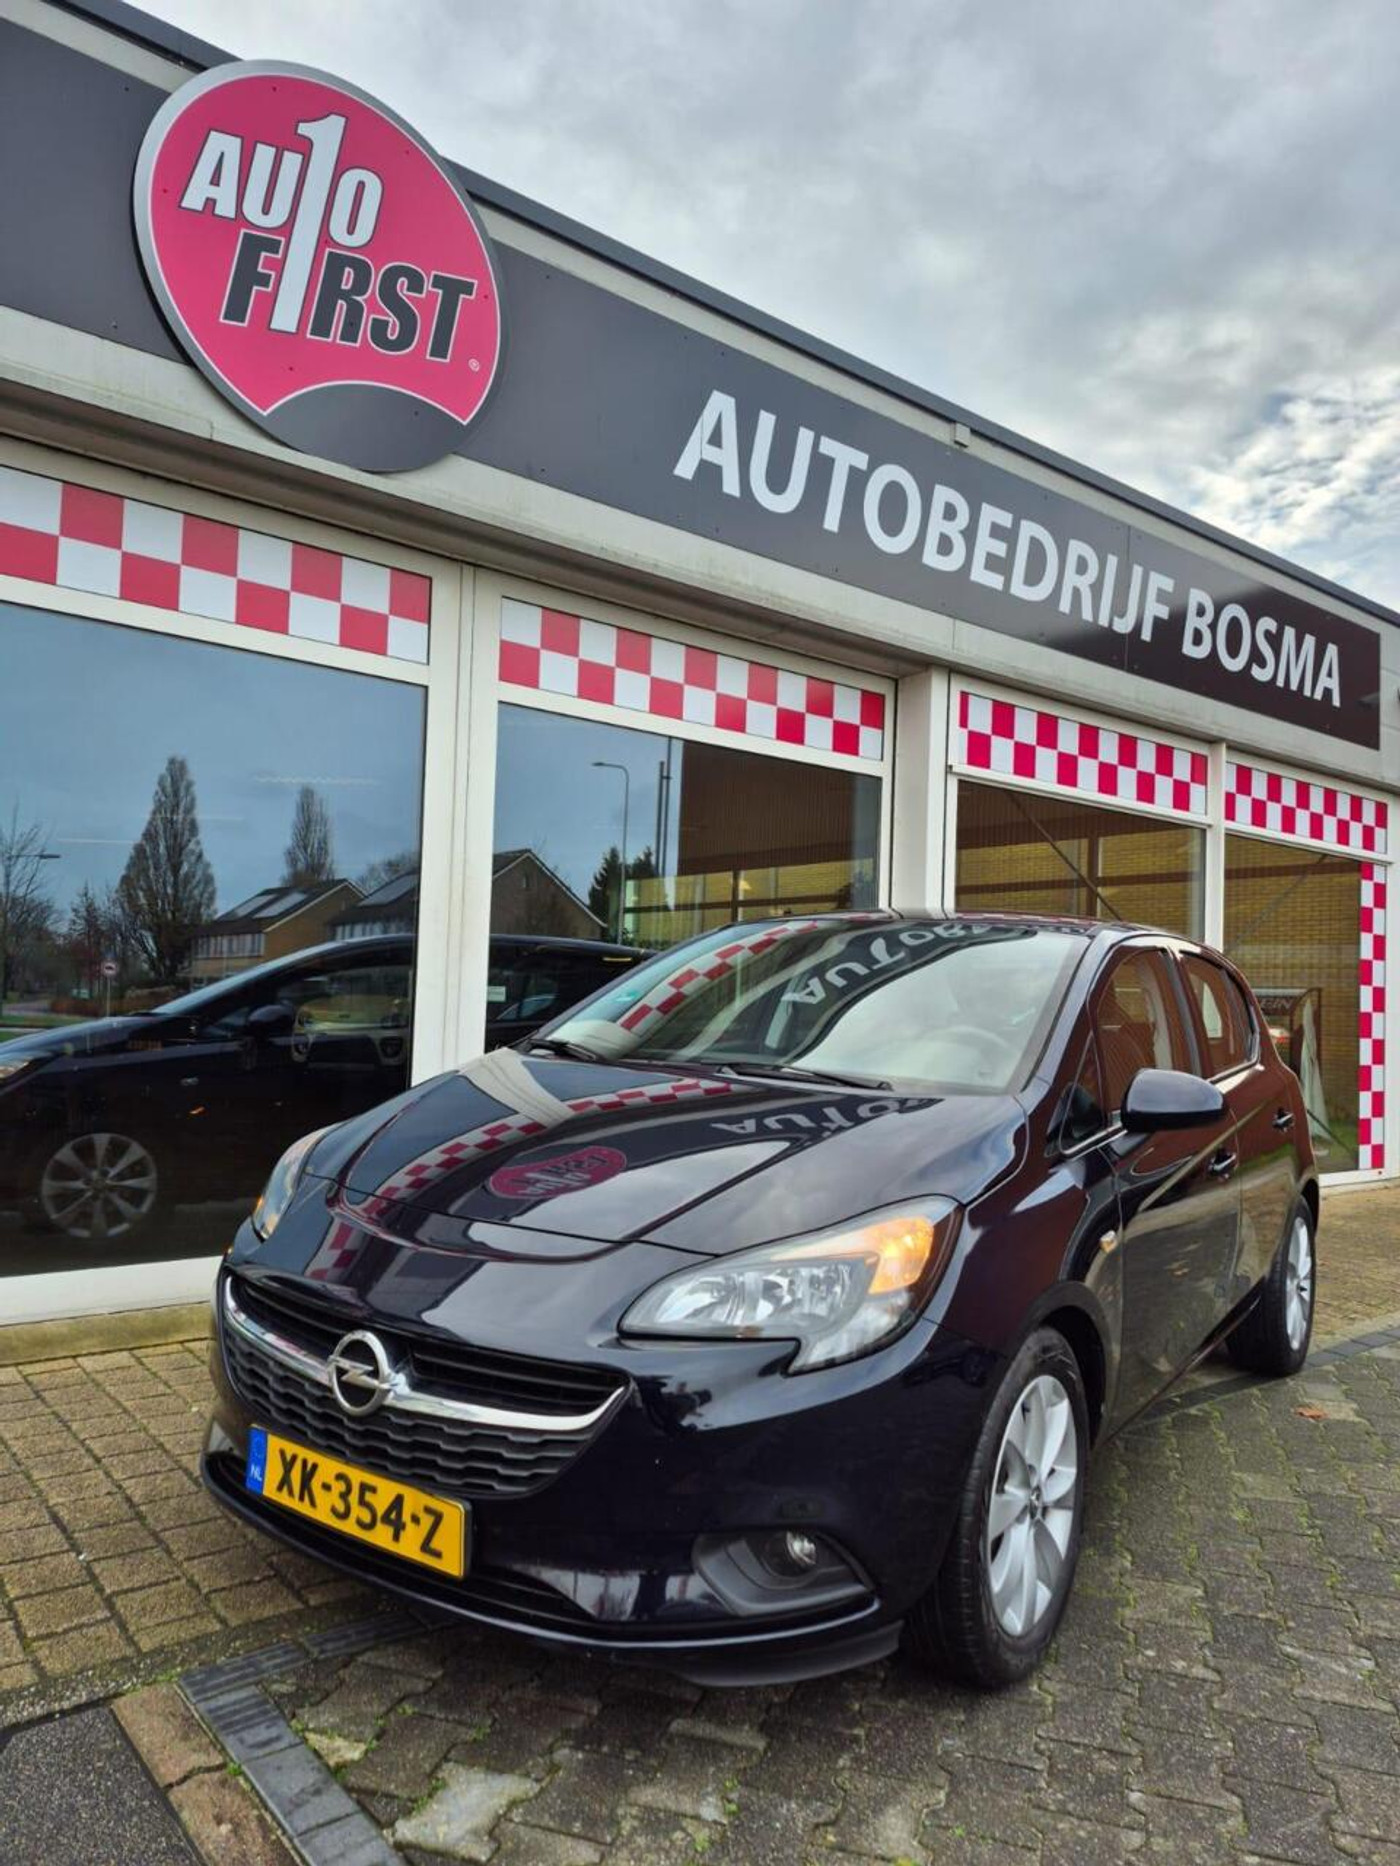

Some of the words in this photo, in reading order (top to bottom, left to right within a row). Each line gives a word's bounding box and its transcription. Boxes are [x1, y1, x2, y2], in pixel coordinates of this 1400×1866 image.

[673, 389, 1174, 643] AUTOBEDRIJF
[1181, 587, 1342, 708] BOSMA
[275, 1447, 445, 1560] XK-354-Z
